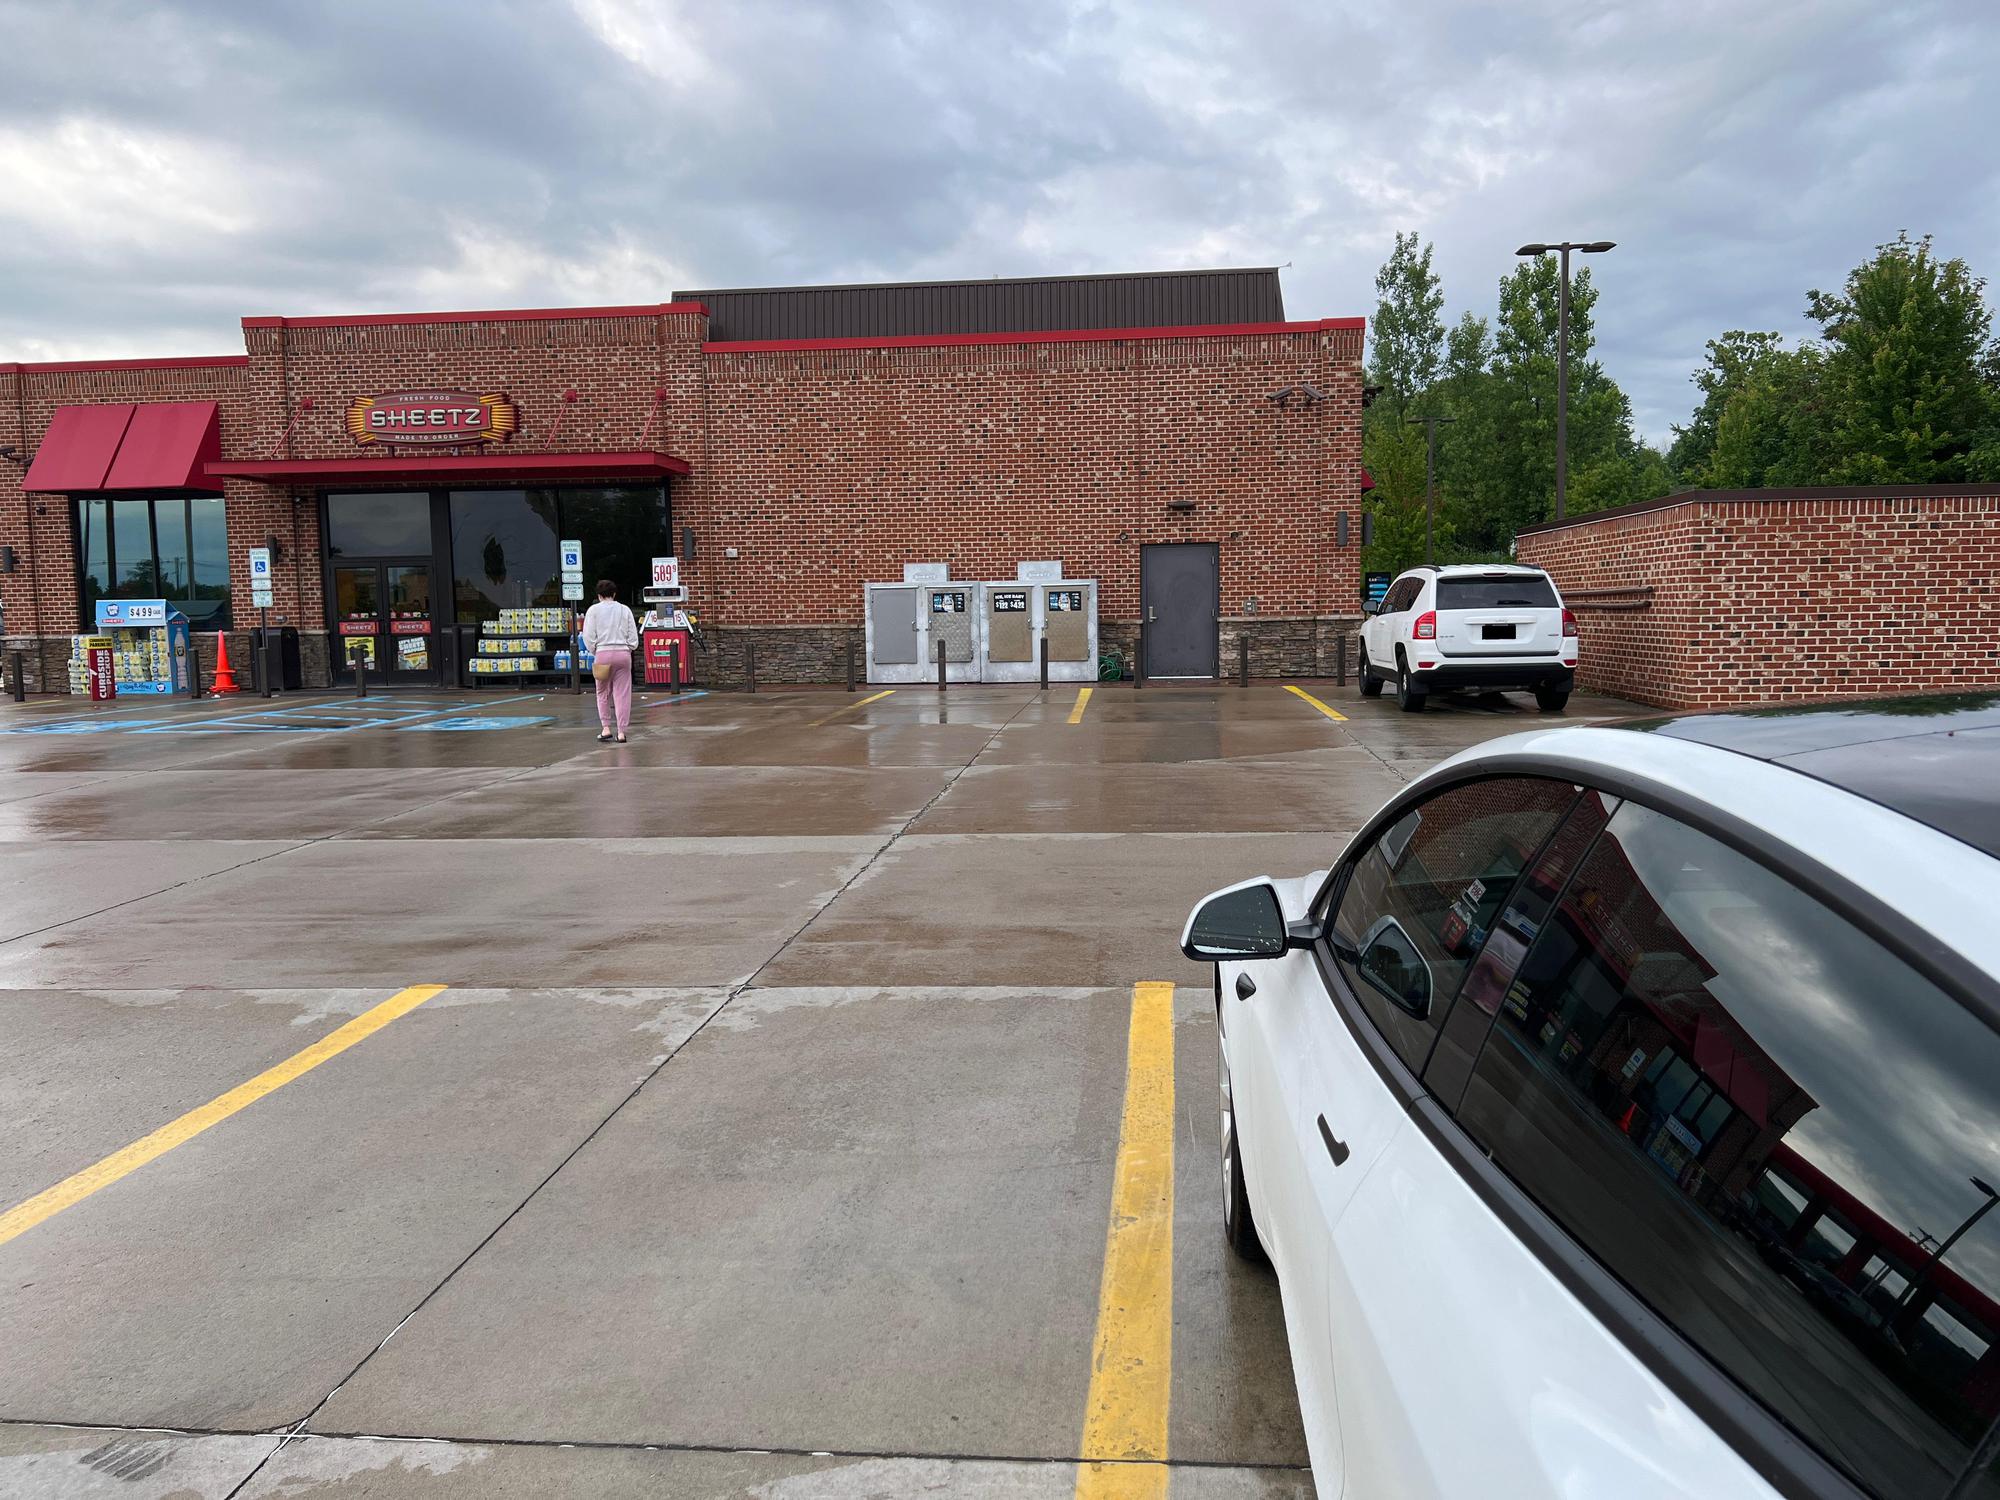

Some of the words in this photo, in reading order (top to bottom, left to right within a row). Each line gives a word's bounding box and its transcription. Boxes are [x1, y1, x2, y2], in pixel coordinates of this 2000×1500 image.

[371, 408, 481, 427] SHEETZ
[96, 650, 107, 699] CURBSIDE
[104, 649, 112, 685] PICKUP
